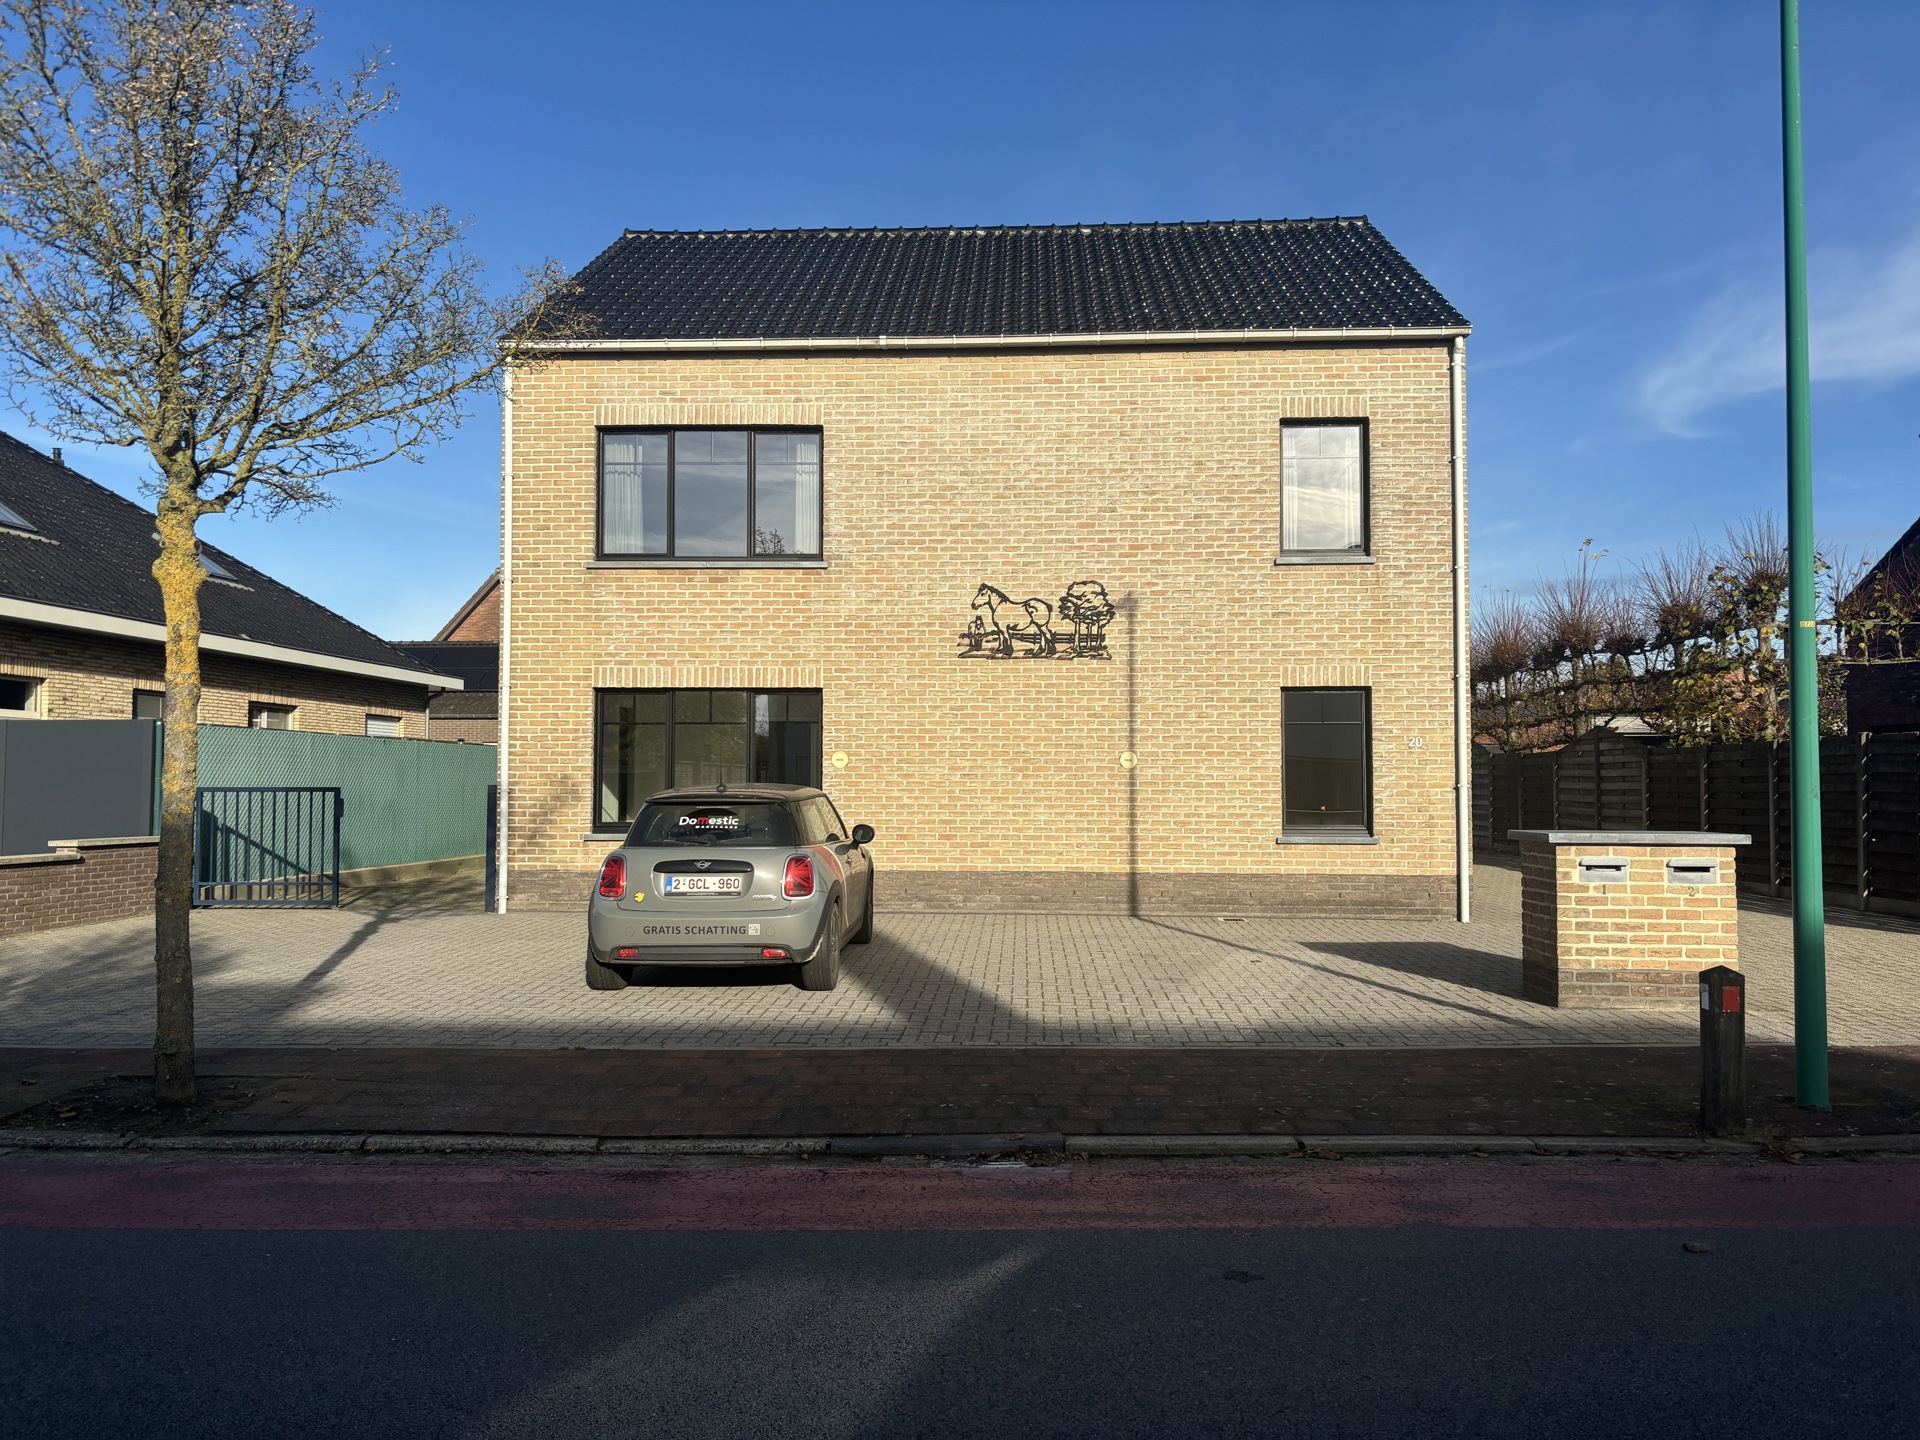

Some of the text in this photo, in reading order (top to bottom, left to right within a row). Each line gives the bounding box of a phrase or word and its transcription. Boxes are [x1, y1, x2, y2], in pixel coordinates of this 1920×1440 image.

[1409, 737, 1423, 747] 20
[679, 816, 739, 826] Domestic
[1601, 884, 1606, 895] 1
[643, 925, 746, 935] GRATIS SCHATTING
